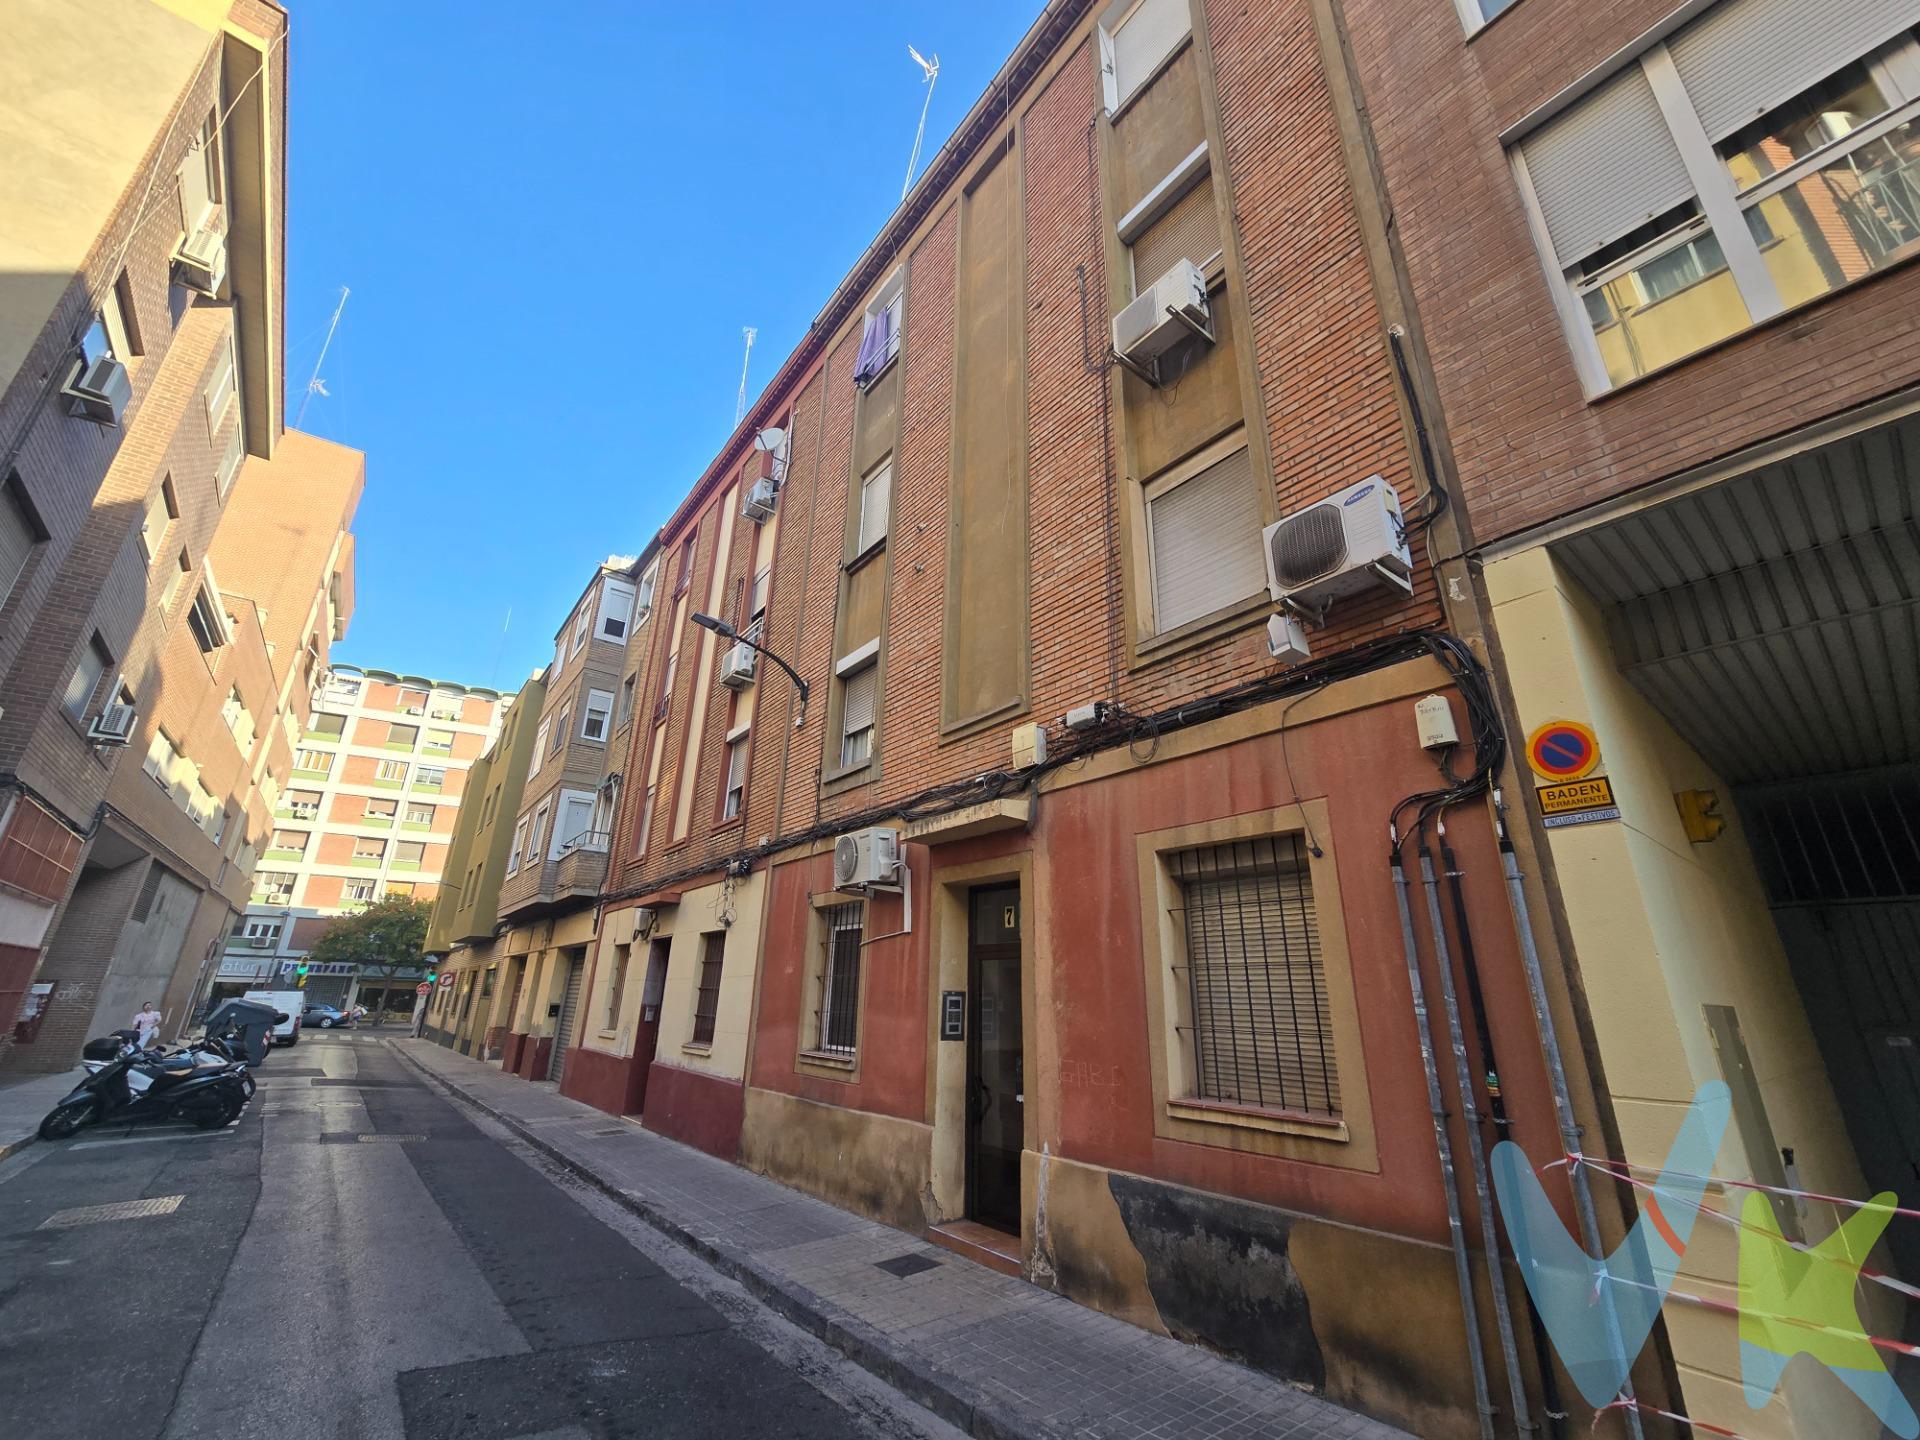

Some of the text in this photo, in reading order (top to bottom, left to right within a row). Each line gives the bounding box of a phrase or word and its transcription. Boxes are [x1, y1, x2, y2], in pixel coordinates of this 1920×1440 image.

[1546, 783, 1602, 801] BADEN
[1545, 794, 1609, 810] PERMANENTE
[1547, 810, 1616, 826] INCLUSO FESTIVOS
[1006, 908, 1013, 926] 7
